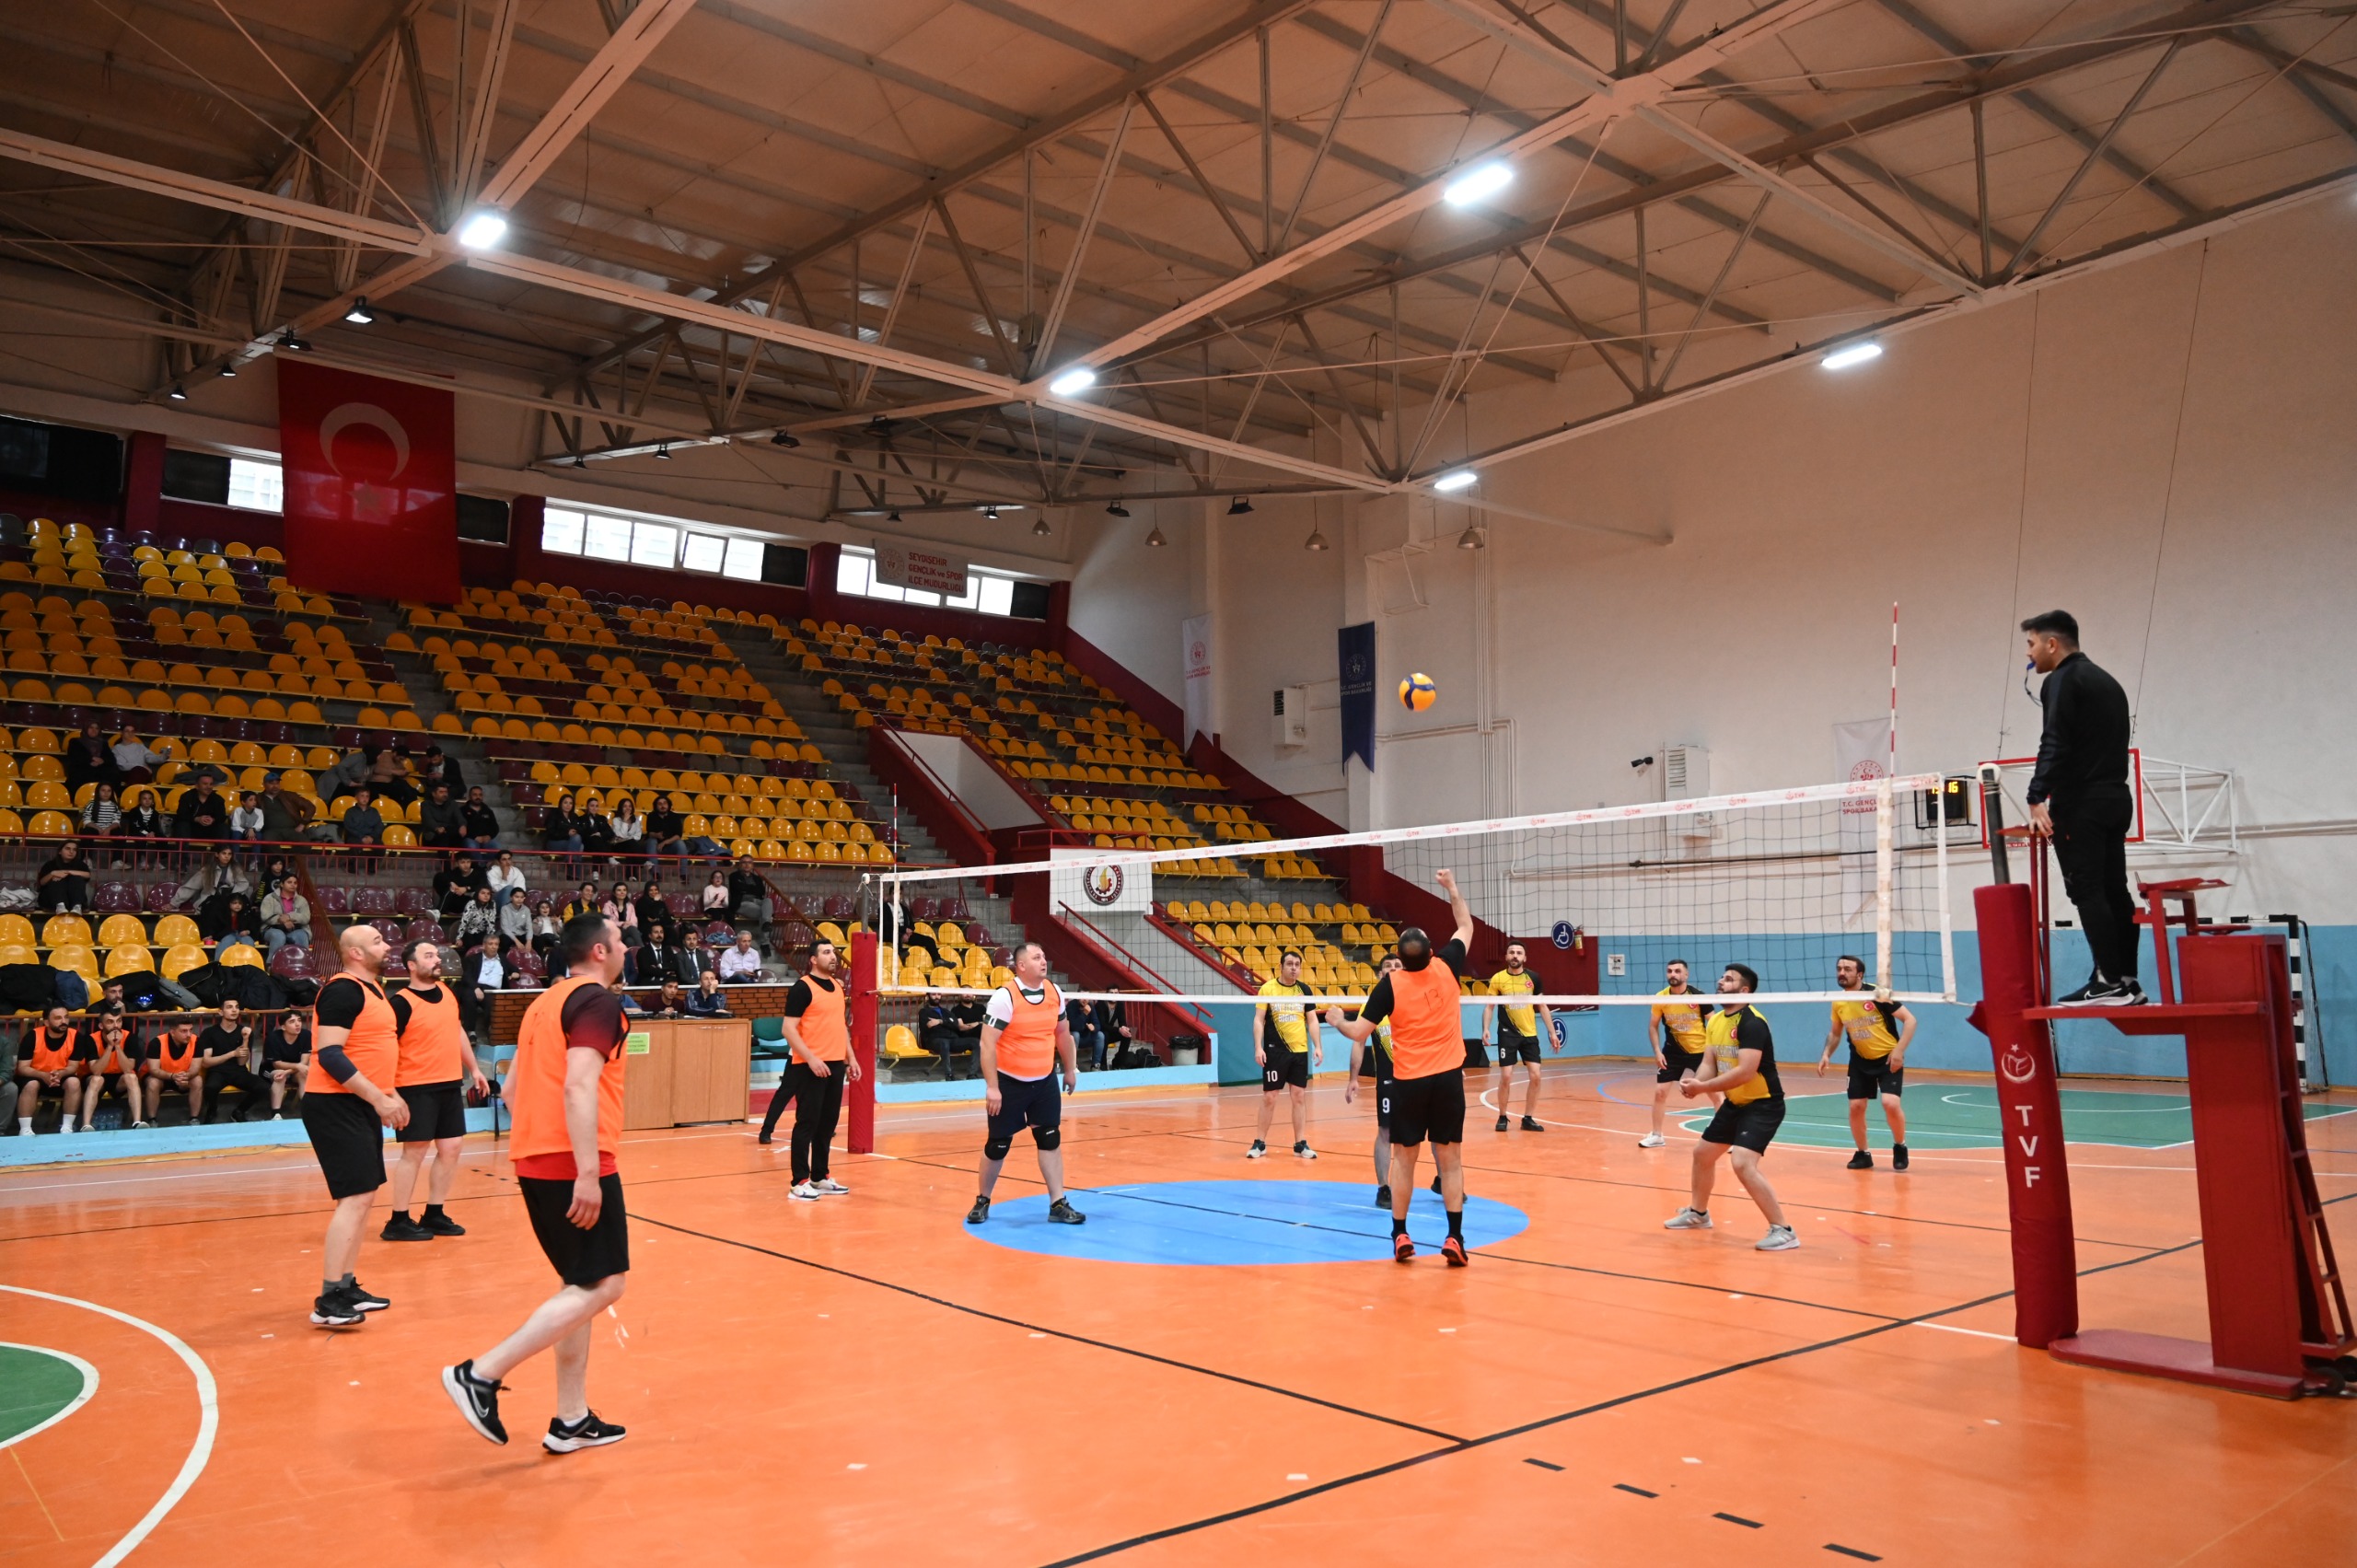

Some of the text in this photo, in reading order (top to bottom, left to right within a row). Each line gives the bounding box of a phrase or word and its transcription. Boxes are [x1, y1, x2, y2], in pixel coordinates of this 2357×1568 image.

[946, 571, 963, 580] SPOR
[1855, 798, 1877, 807] GENÇL
[1423, 988, 1445, 1011] 13
[1500, 1048, 1506, 1059] 6
[1266, 1070, 1278, 1083] 10
[1382, 1098, 1390, 1114] 9
[2014, 1105, 2041, 1189] TVF
